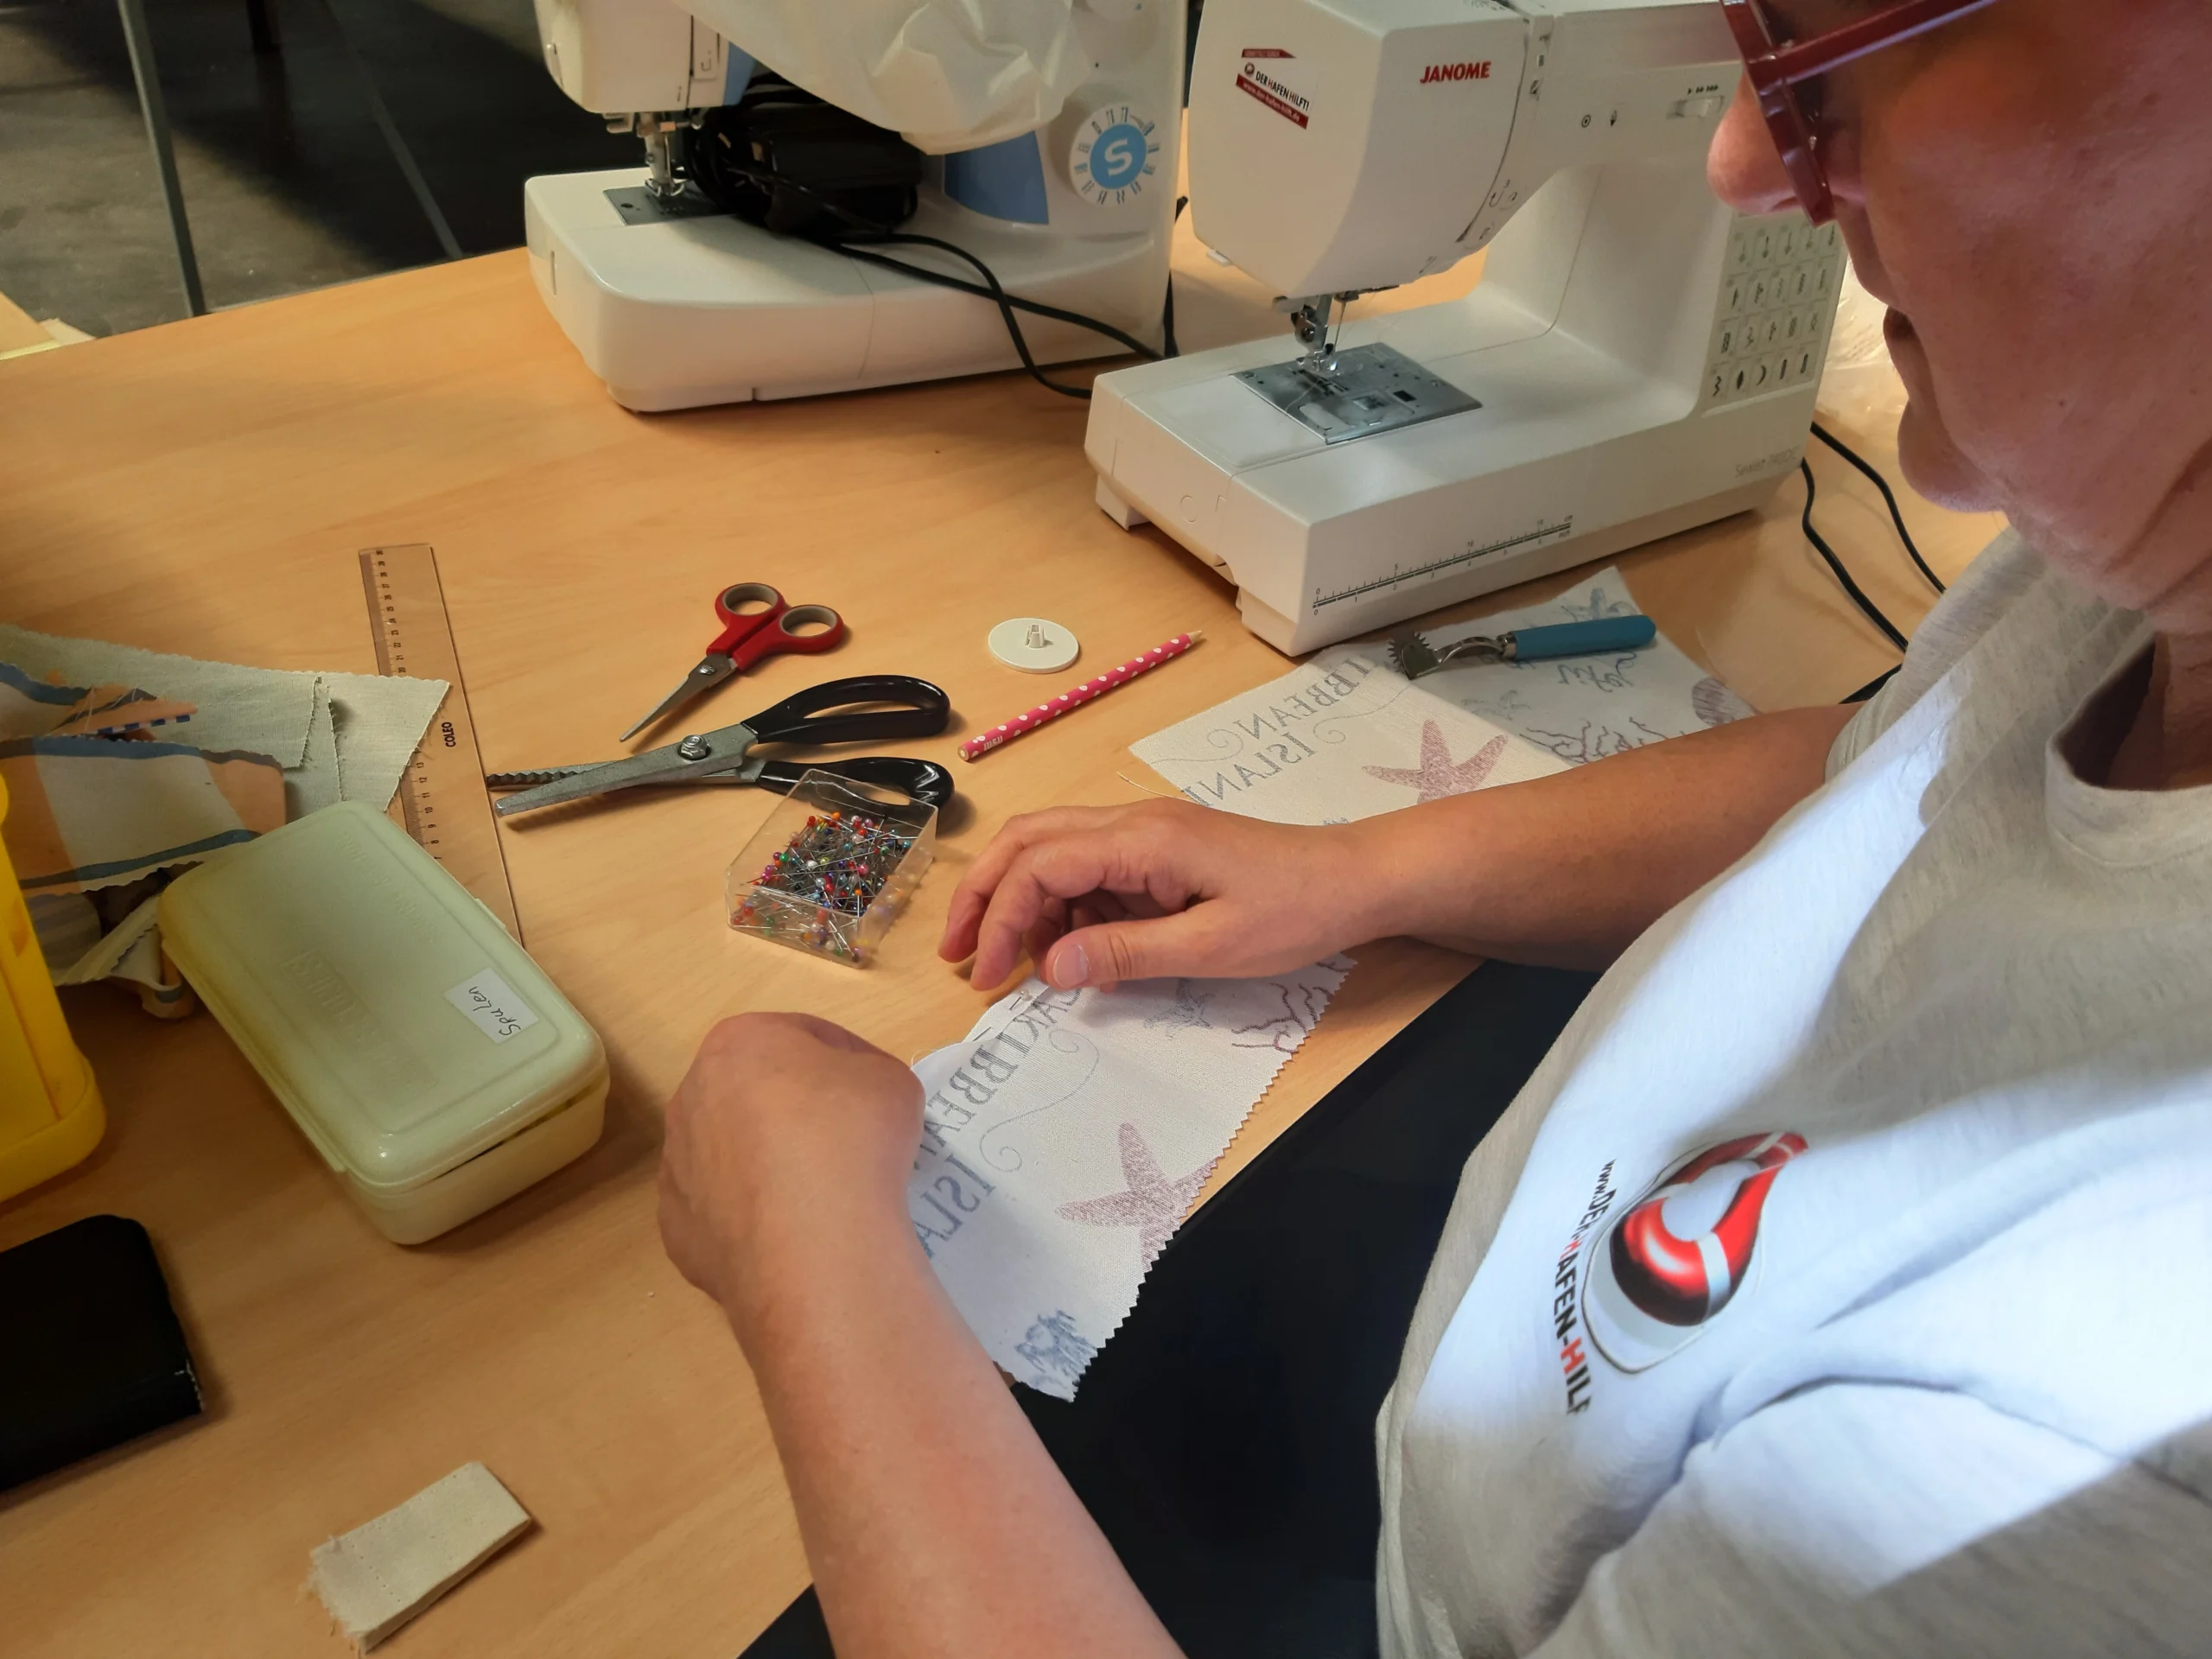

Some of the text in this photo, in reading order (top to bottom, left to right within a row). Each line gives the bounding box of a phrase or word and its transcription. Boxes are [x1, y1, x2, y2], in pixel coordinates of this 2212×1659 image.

[1420, 60, 1492, 85] JANOME
[441, 721, 456, 747] COLEO
[468, 986, 521, 1036] Spulen
